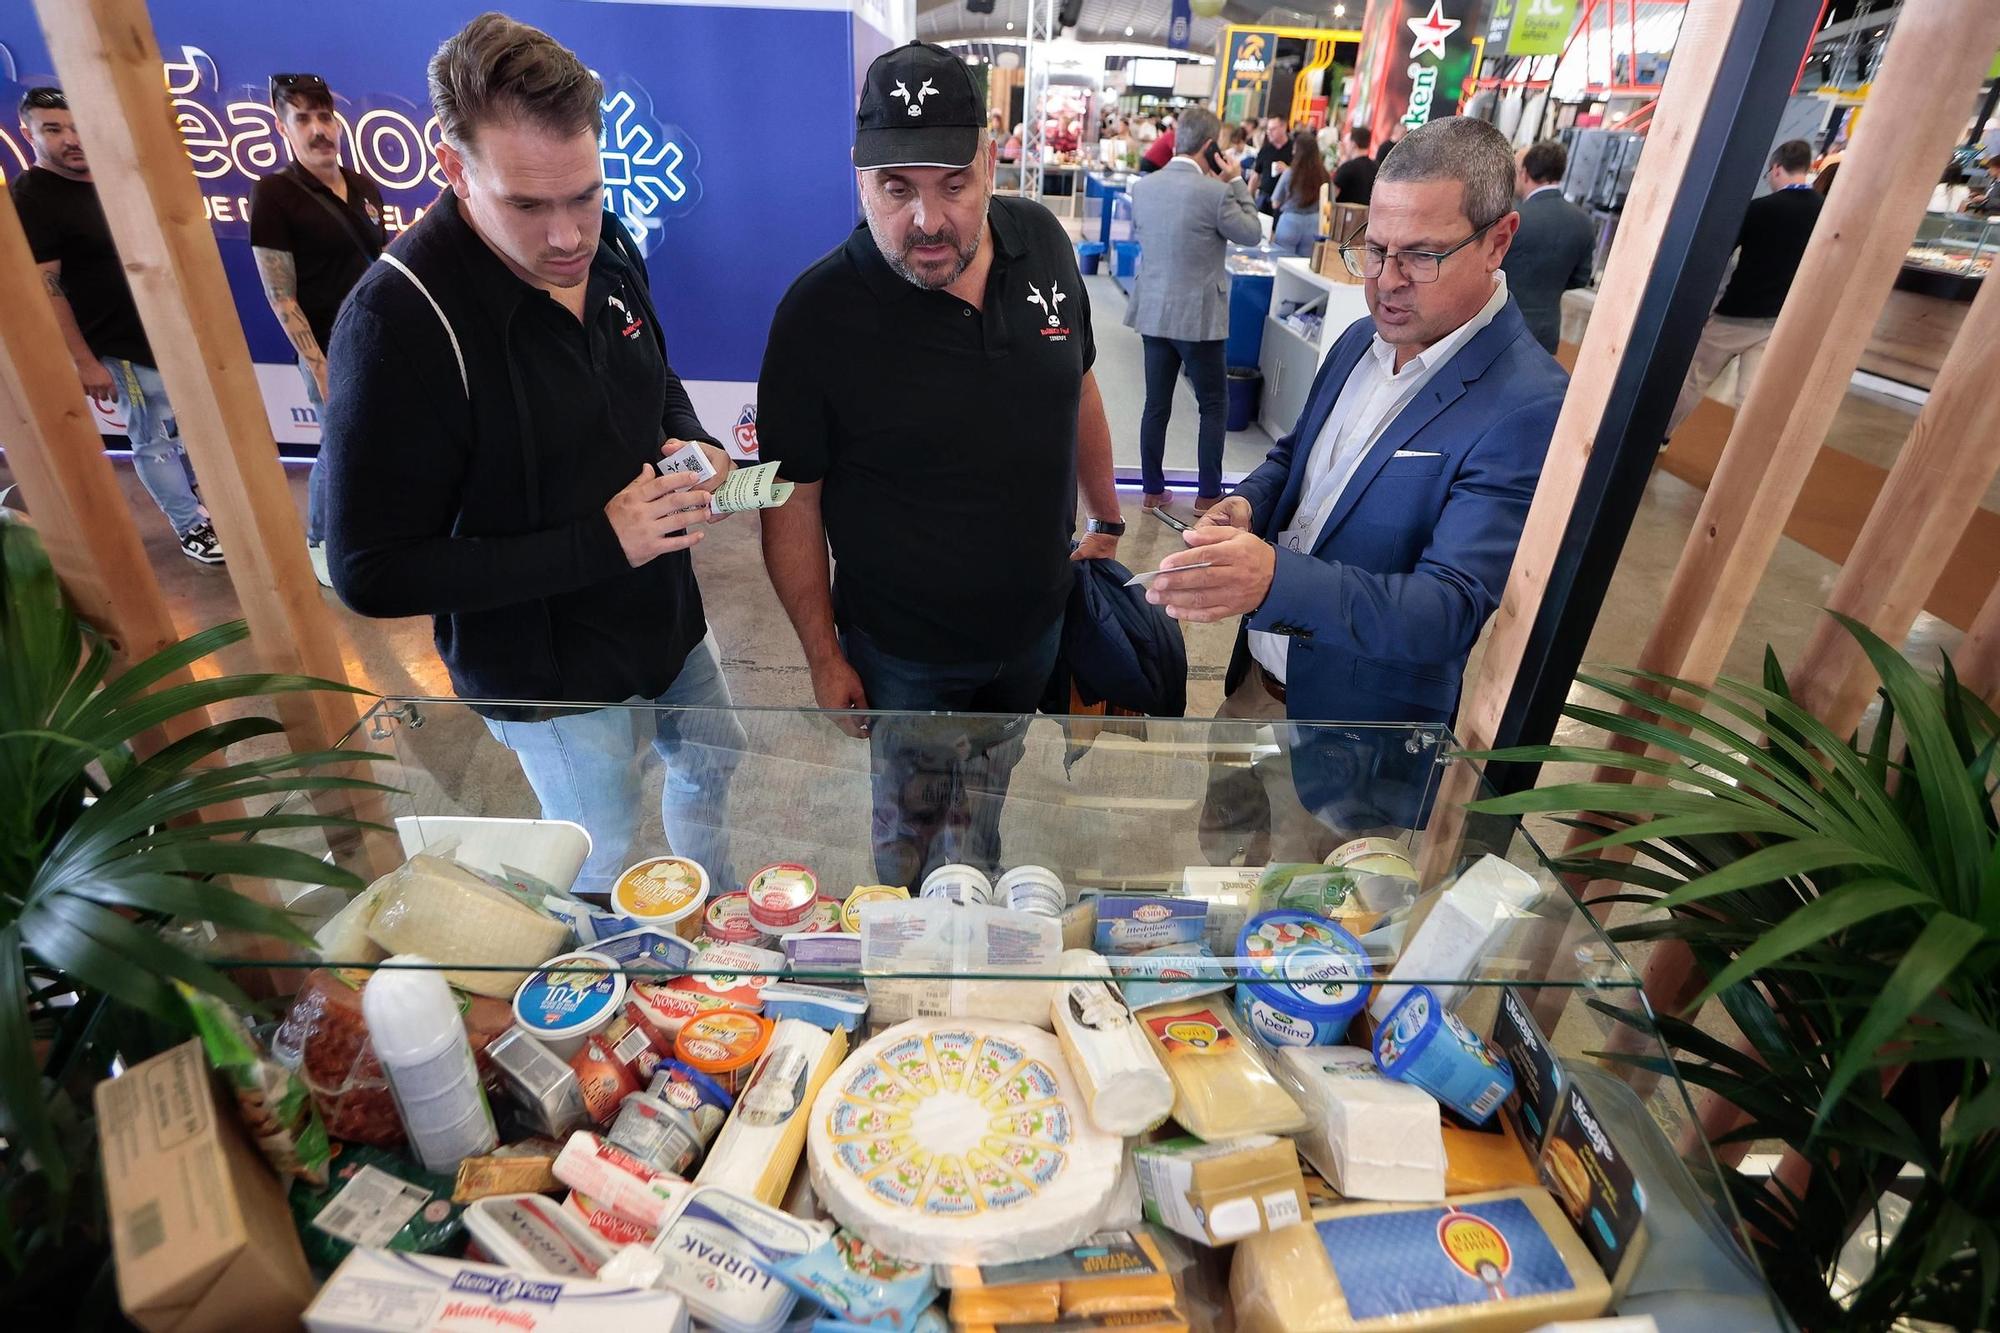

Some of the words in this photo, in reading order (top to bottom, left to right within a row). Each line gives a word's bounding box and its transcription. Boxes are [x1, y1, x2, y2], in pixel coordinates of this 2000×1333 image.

[546, 986, 591, 1004] AZUL
[652, 993, 697, 1016] SOIGNON
[1254, 1009, 1311, 1039] Apetina
[1506, 992, 1538, 1052] Violife
[1571, 1090, 1614, 1162] Violife
[681, 1232, 775, 1291] LURPAK
